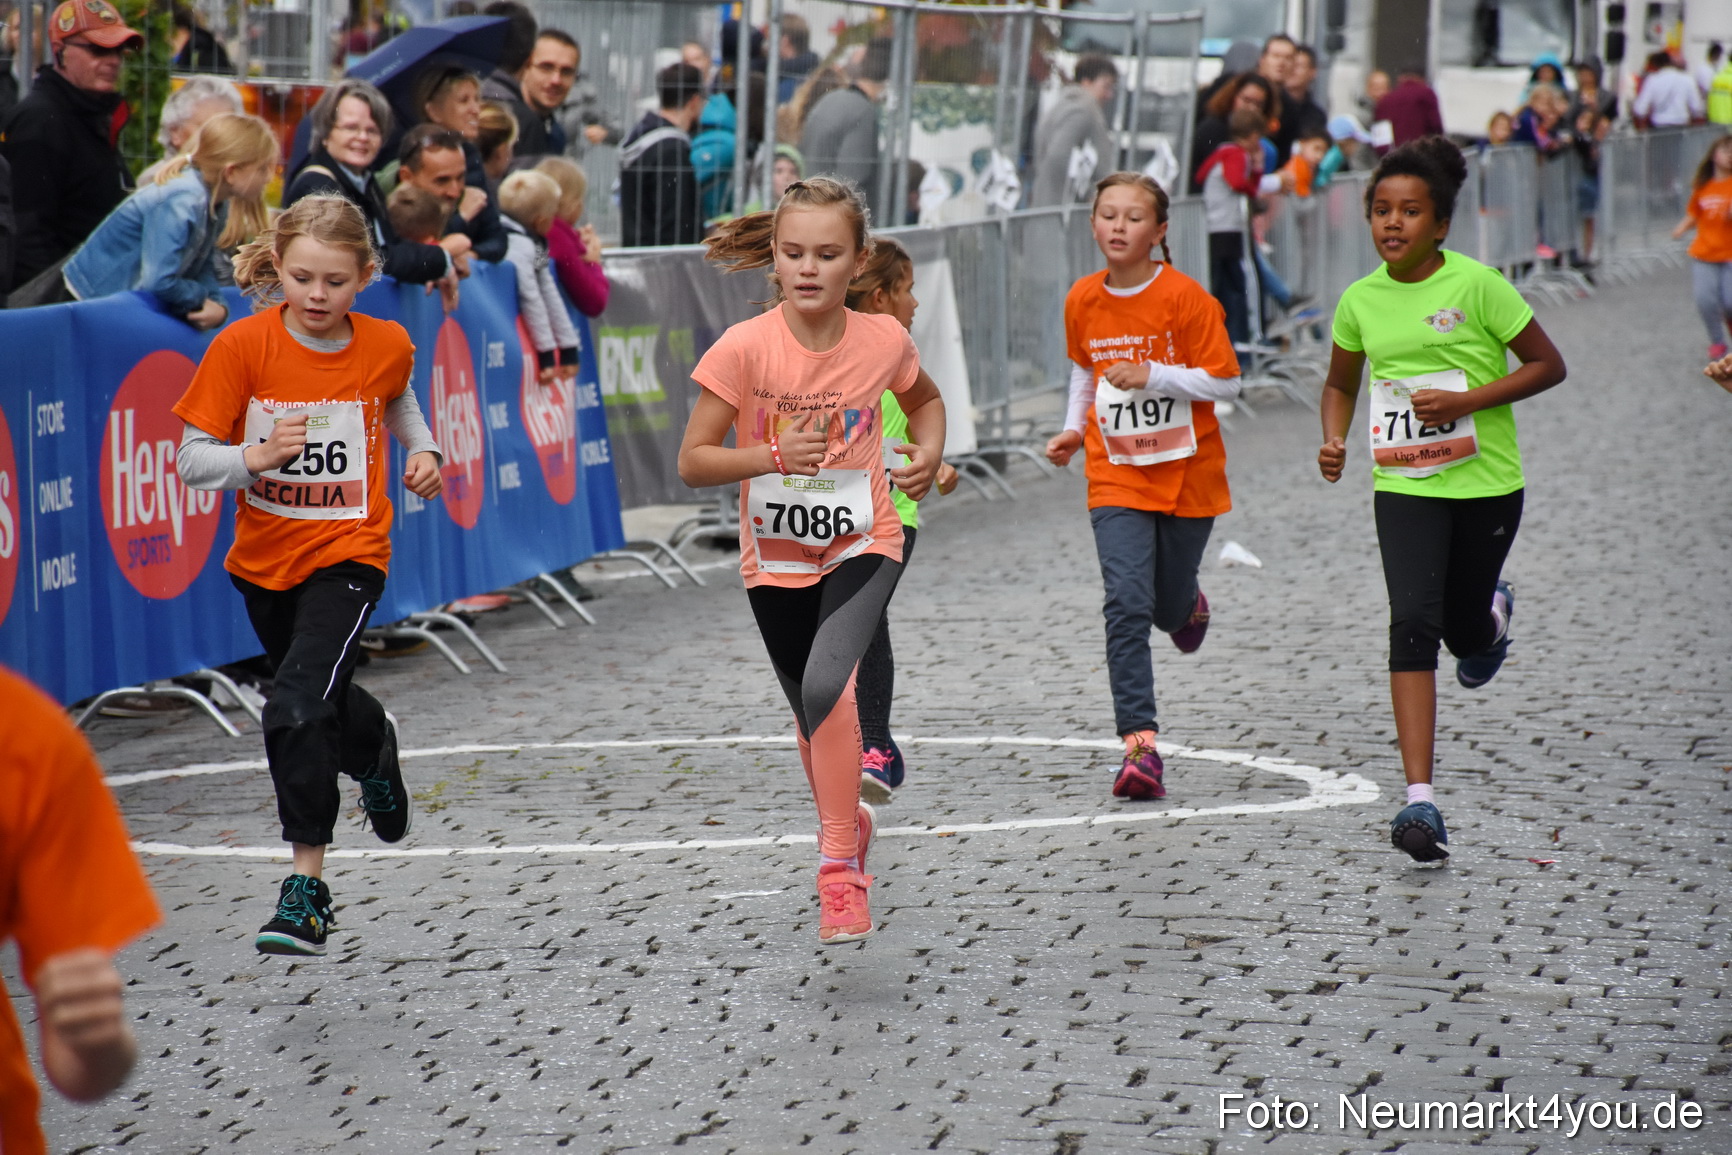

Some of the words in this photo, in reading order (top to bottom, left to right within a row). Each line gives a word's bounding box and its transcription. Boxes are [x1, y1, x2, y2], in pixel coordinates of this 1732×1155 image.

[753, 387, 776, 399] When
[780, 392, 802, 401] skies
[805, 392, 820, 400] are
[822, 390, 843, 402] gray
[777, 402, 798, 412] YOU
[37, 401, 65, 437] STORE
[1109, 396, 1176, 430] 7197
[1136, 438, 1158, 449] Mira
[39, 475, 73, 514] ONLINE
[794, 479, 835, 489] BOCK
[766, 502, 855, 540] 7086
[128, 534, 171, 568] SPORTS
[42, 553, 77, 592] MOBILE
